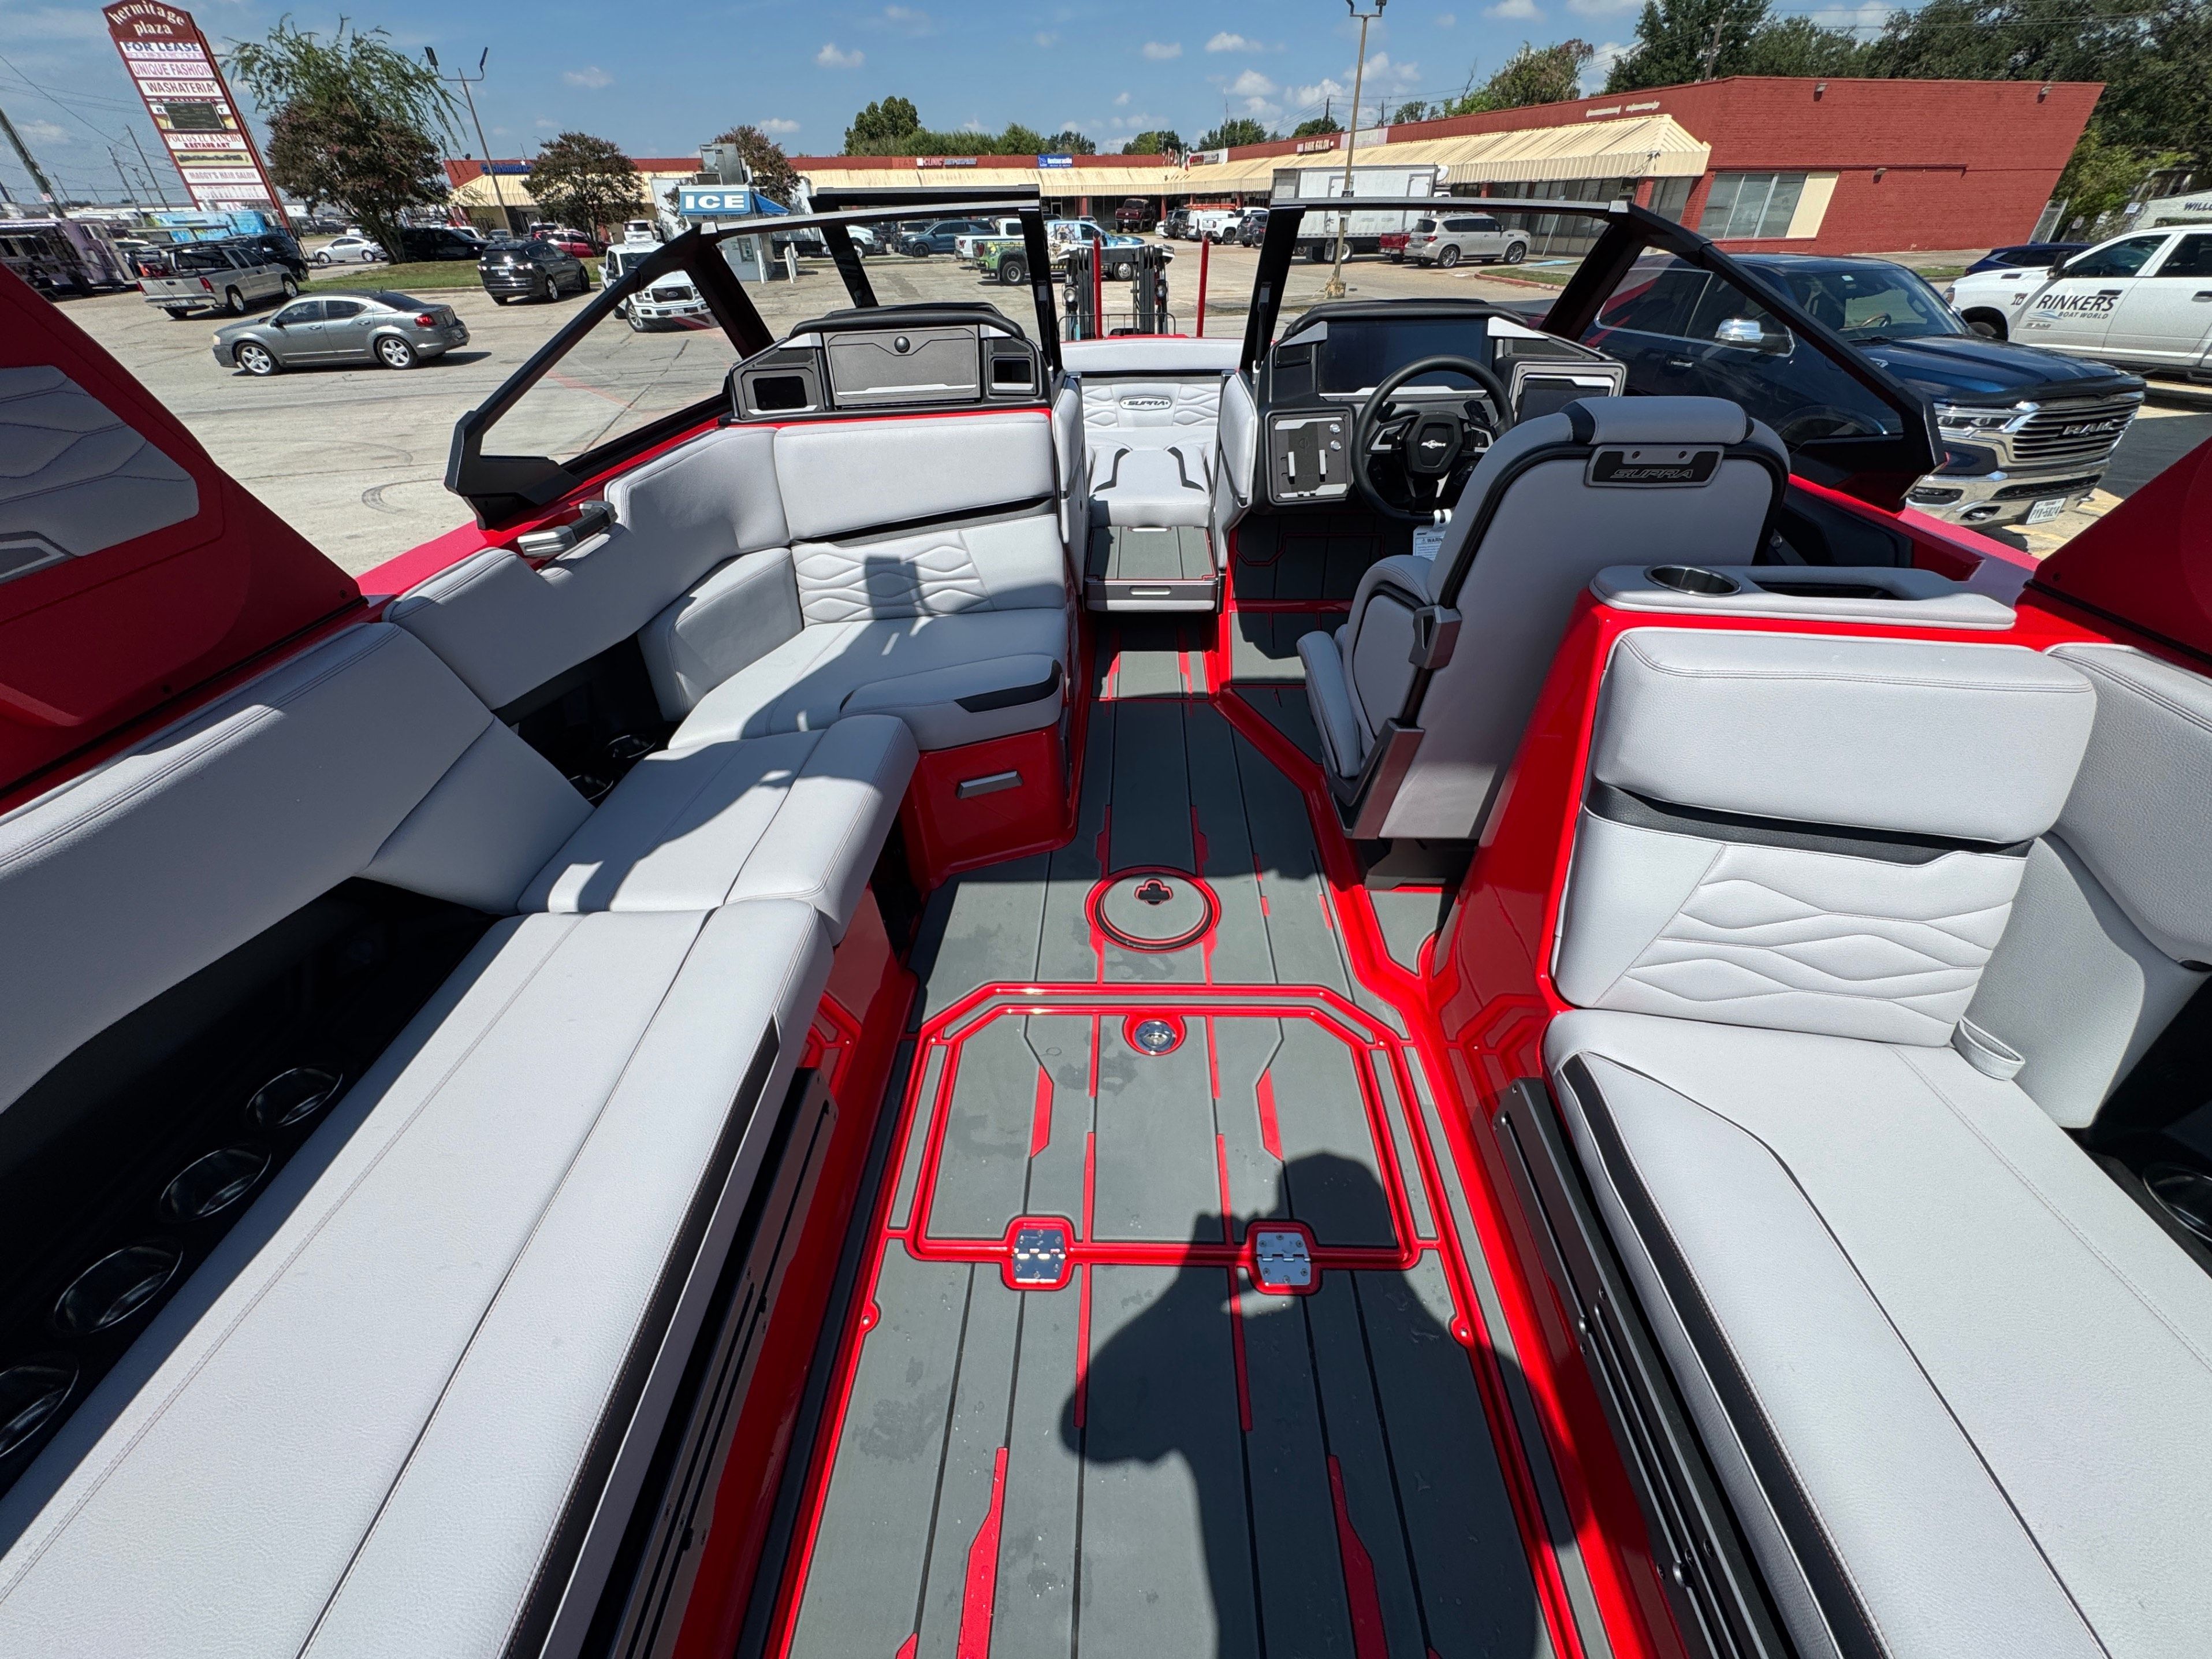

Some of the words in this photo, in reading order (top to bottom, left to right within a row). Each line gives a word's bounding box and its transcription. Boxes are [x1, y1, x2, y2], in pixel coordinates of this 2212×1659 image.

[108, 1, 185, 26] hermitage
[133, 20, 173, 36] plaza
[124, 43, 154, 52] FOR
[156, 43, 200, 52] LEASE
[131, 62, 170, 76] UNIQUE
[170, 62, 213, 76] FASHION
[146, 81, 215, 93] WASHATERIA
[166, 134, 197, 143] POLLOS
[924, 158, 943, 166] CLINIC
[686, 195, 744, 209] ICE
[2036, 295, 2119, 312] RINKERS
[2062, 422, 2113, 435] RAM
[1610, 468, 1694, 479] SUPRA
